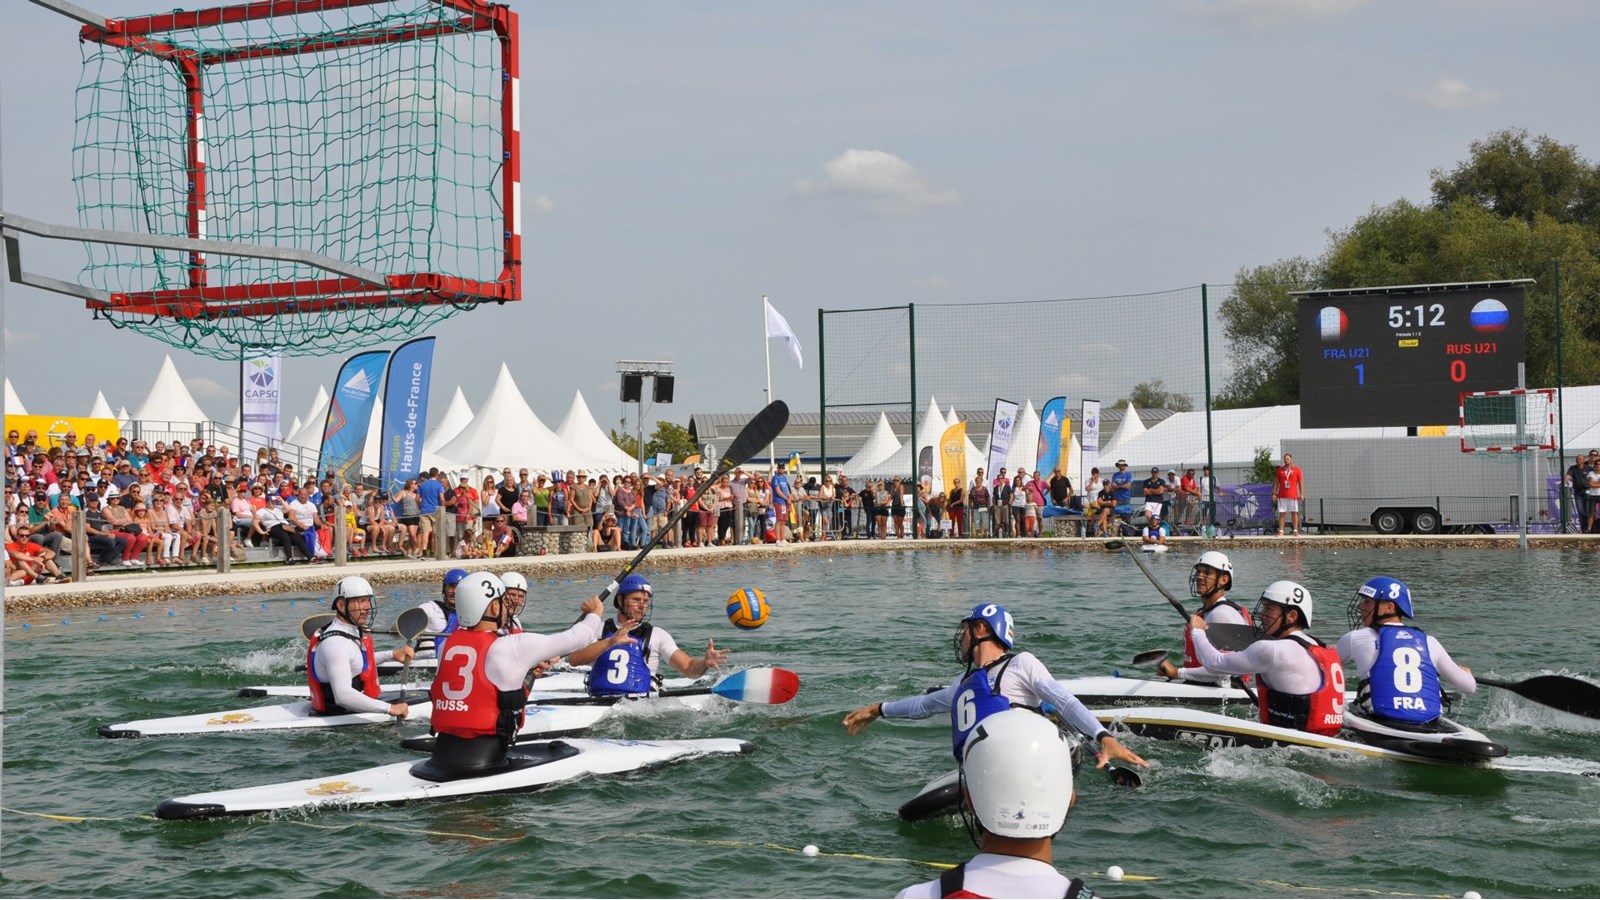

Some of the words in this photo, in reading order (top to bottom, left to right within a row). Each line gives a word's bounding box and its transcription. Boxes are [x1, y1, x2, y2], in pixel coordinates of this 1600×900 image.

[1388, 303, 1445, 328] 5:12
[1324, 348, 1346, 359] FRA
[1349, 347, 1370, 358] U21
[1446, 343, 1472, 355] RUS
[1474, 342, 1497, 354] U21
[1354, 363, 1365, 385] 1
[1450, 359, 1467, 383] 0
[245, 389, 279, 398] CAPSO
[400, 361, 422, 473] Hauts-de-France
[389, 434, 402, 472] Région
[481, 580, 495, 598] 3
[1292, 587, 1304, 604] 9
[1388, 582, 1401, 599] 8
[981, 604, 998, 617] 6
[442, 645, 477, 701] 3
[606, 648, 630, 685] 3
[1392, 646, 1423, 694] 8
[1330, 662, 1345, 714] 9
[956, 688, 977, 732] 6
[1392, 696, 1427, 712] FRA
